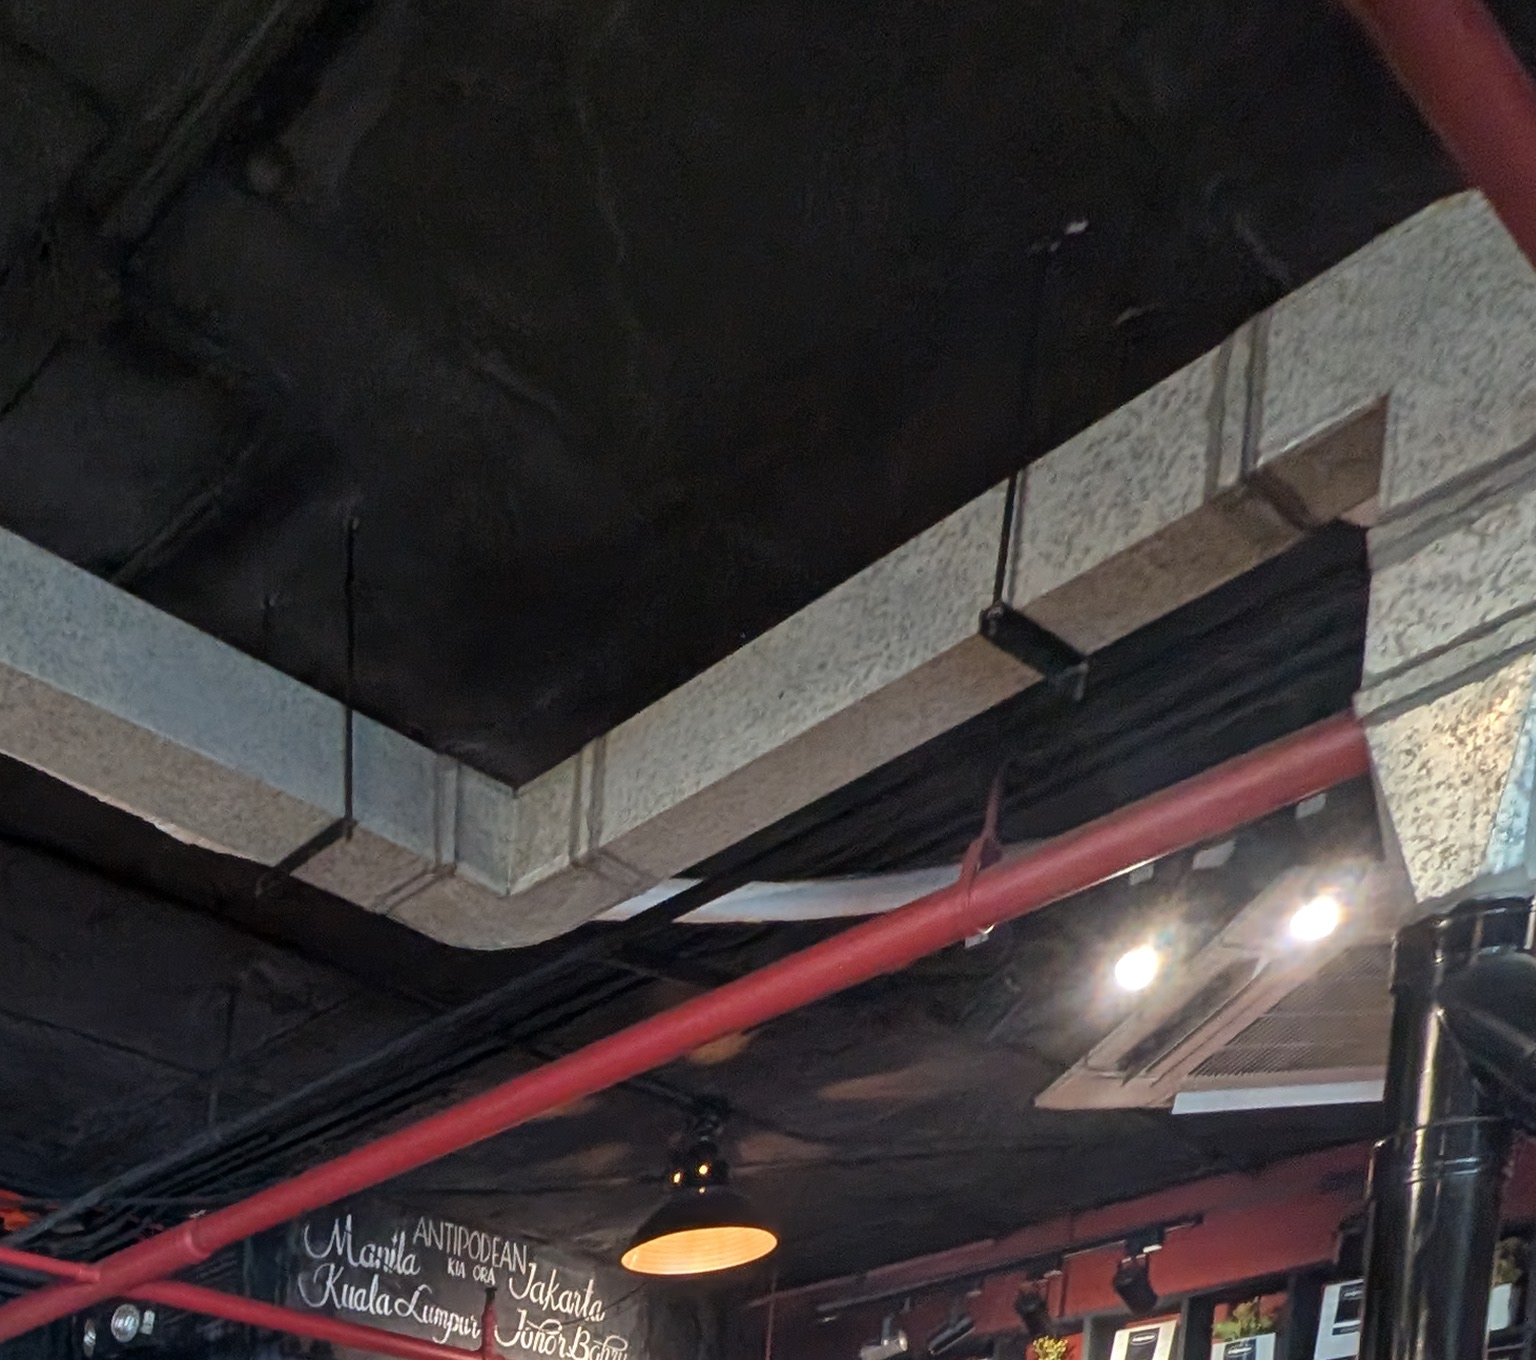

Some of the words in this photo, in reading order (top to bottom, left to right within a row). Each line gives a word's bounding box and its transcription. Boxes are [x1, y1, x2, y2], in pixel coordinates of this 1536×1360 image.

[304, 1214, 421, 1275] Manila
[414, 1216, 527, 1274] ANTIPODEAN
[447, 1257, 465, 1277] KIA
[473, 1263, 495, 1285] ORA
[298, 1263, 392, 1316] Kuala
[394, 1284, 480, 1344] Lumpur
[509, 1262, 605, 1322] Jakarta
